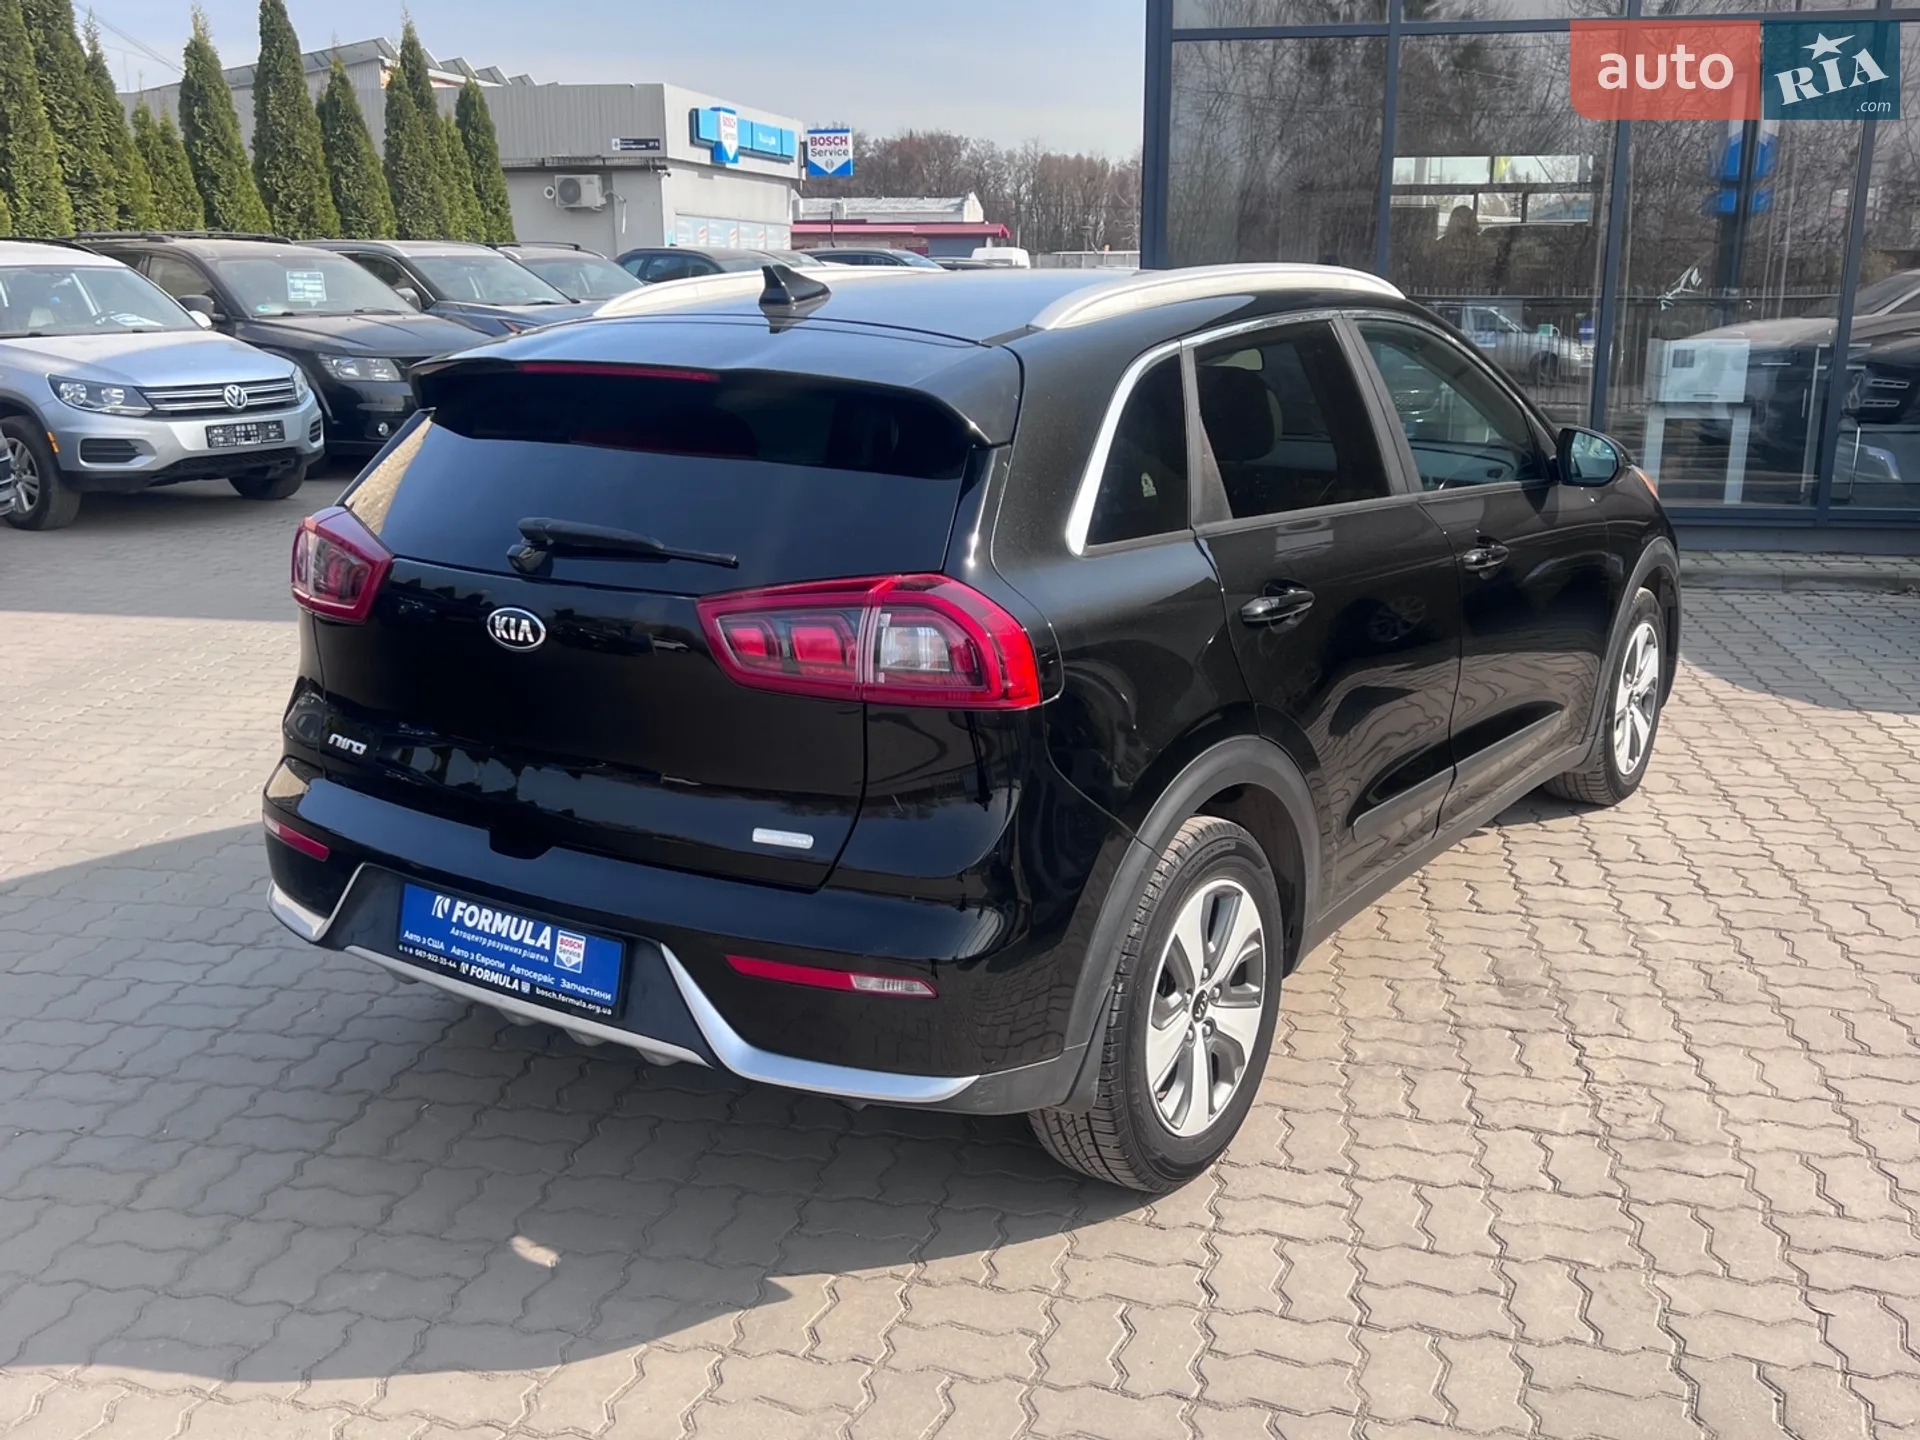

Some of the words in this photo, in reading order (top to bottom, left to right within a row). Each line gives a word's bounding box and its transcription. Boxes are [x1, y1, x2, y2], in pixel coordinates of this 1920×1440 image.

[810, 136, 848, 146] BOSCH
[810, 147, 849, 157] Service
[494, 614, 535, 643] KIA
[451, 900, 550, 950] FORMULA
[450, 926, 487, 946] Автоцентр
[487, 938, 523, 957] розумних
[522, 948, 549, 963] рішень
[559, 946, 582, 958] Service
[560, 937, 583, 950] BOSCH
[403, 930, 421, 943] Авто
[427, 937, 445, 951] США
[450, 945, 470, 958] Авто
[475, 953, 505, 969] Європи
[510, 963, 556, 985] Автосервіс
[560, 978, 612, 1001] Запчастини
[470, 964, 519, 991] FORMULA
[535, 986, 612, 1015] bosch.formula.org.ua
